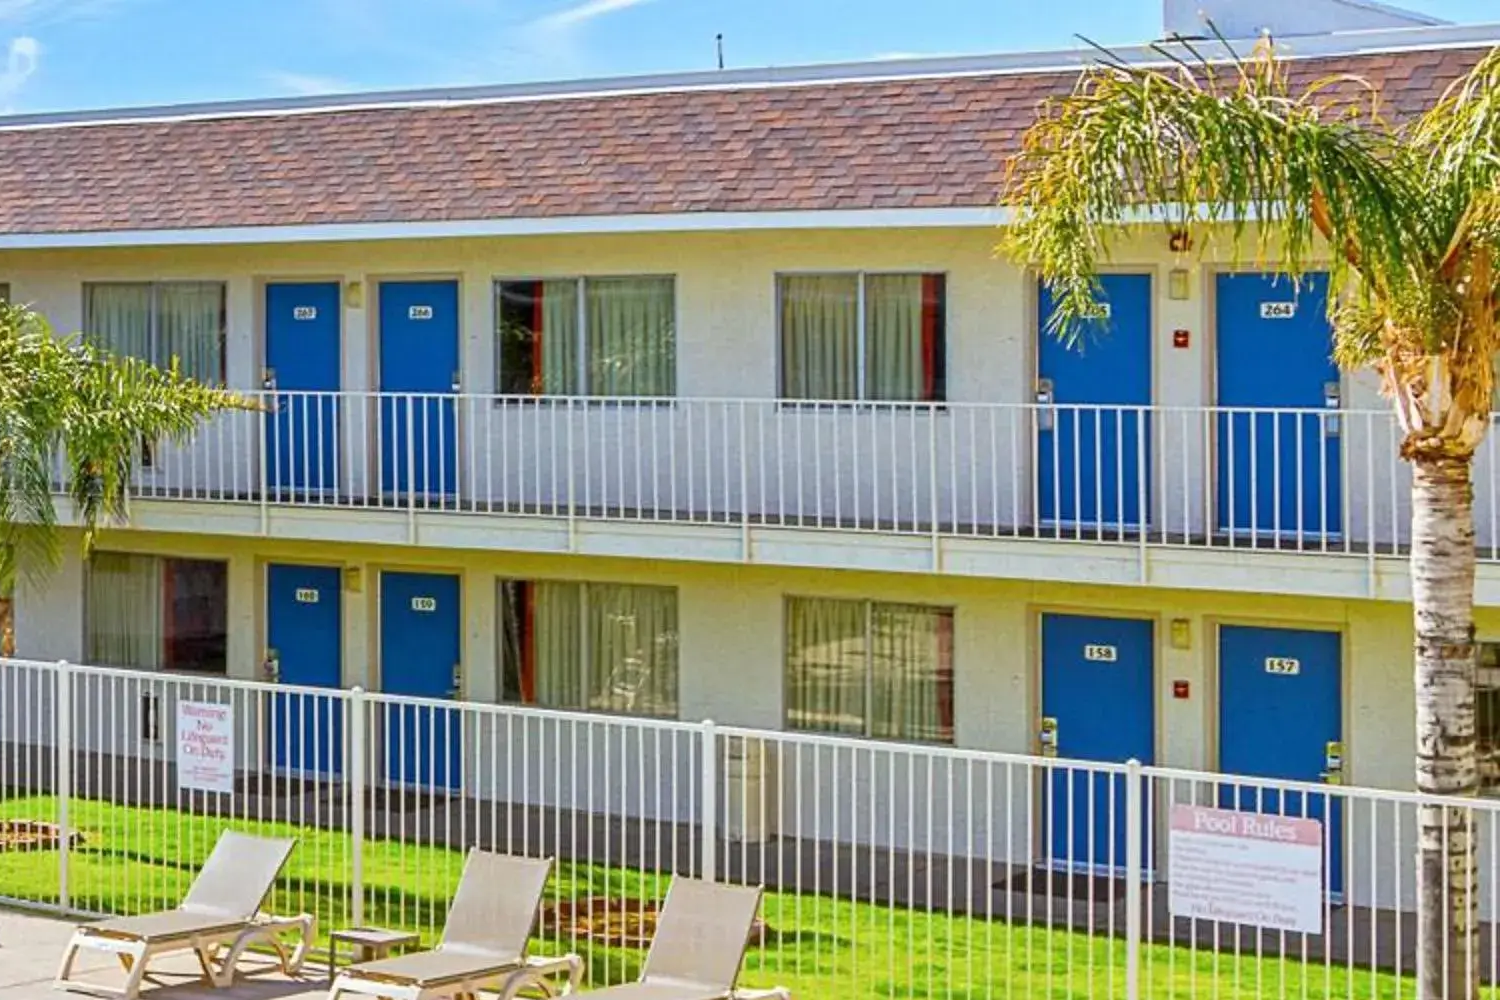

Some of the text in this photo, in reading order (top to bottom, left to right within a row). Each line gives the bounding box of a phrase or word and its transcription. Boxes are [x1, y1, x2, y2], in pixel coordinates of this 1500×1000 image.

[1264, 304, 1291, 316] 264
[1088, 647, 1113, 658] 158
[1268, 659, 1295, 672] 157
[197, 719, 213, 732] No
[1193, 810, 1298, 841] Pool Rules
